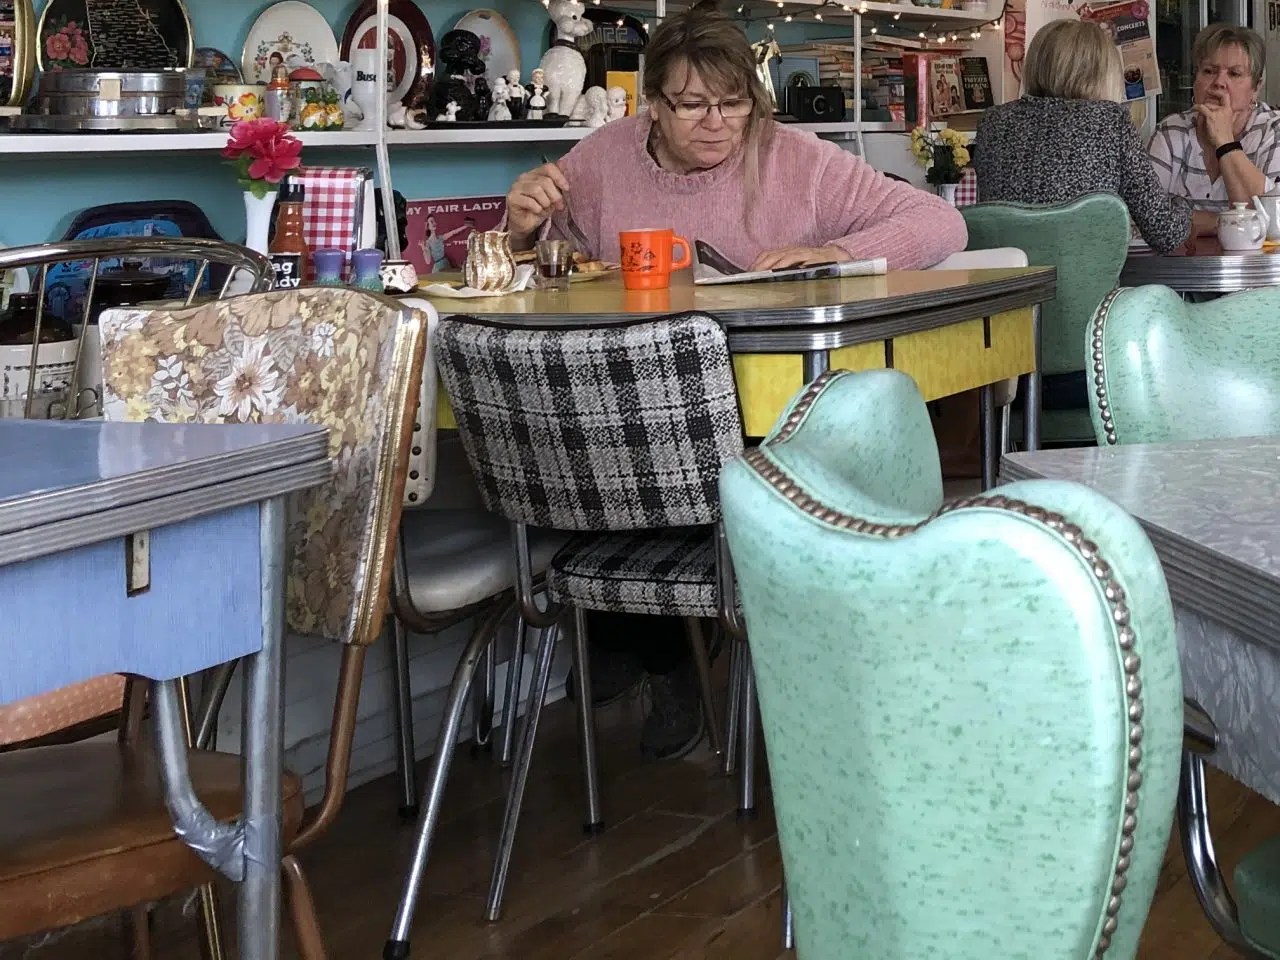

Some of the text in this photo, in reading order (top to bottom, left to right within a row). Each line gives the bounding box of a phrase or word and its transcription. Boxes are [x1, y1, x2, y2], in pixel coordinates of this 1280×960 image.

[1117, 20, 1145, 32] CONCERTS
[406, 201, 502, 215] MY FAIR LADY
[272, 262, 294, 275] ag
